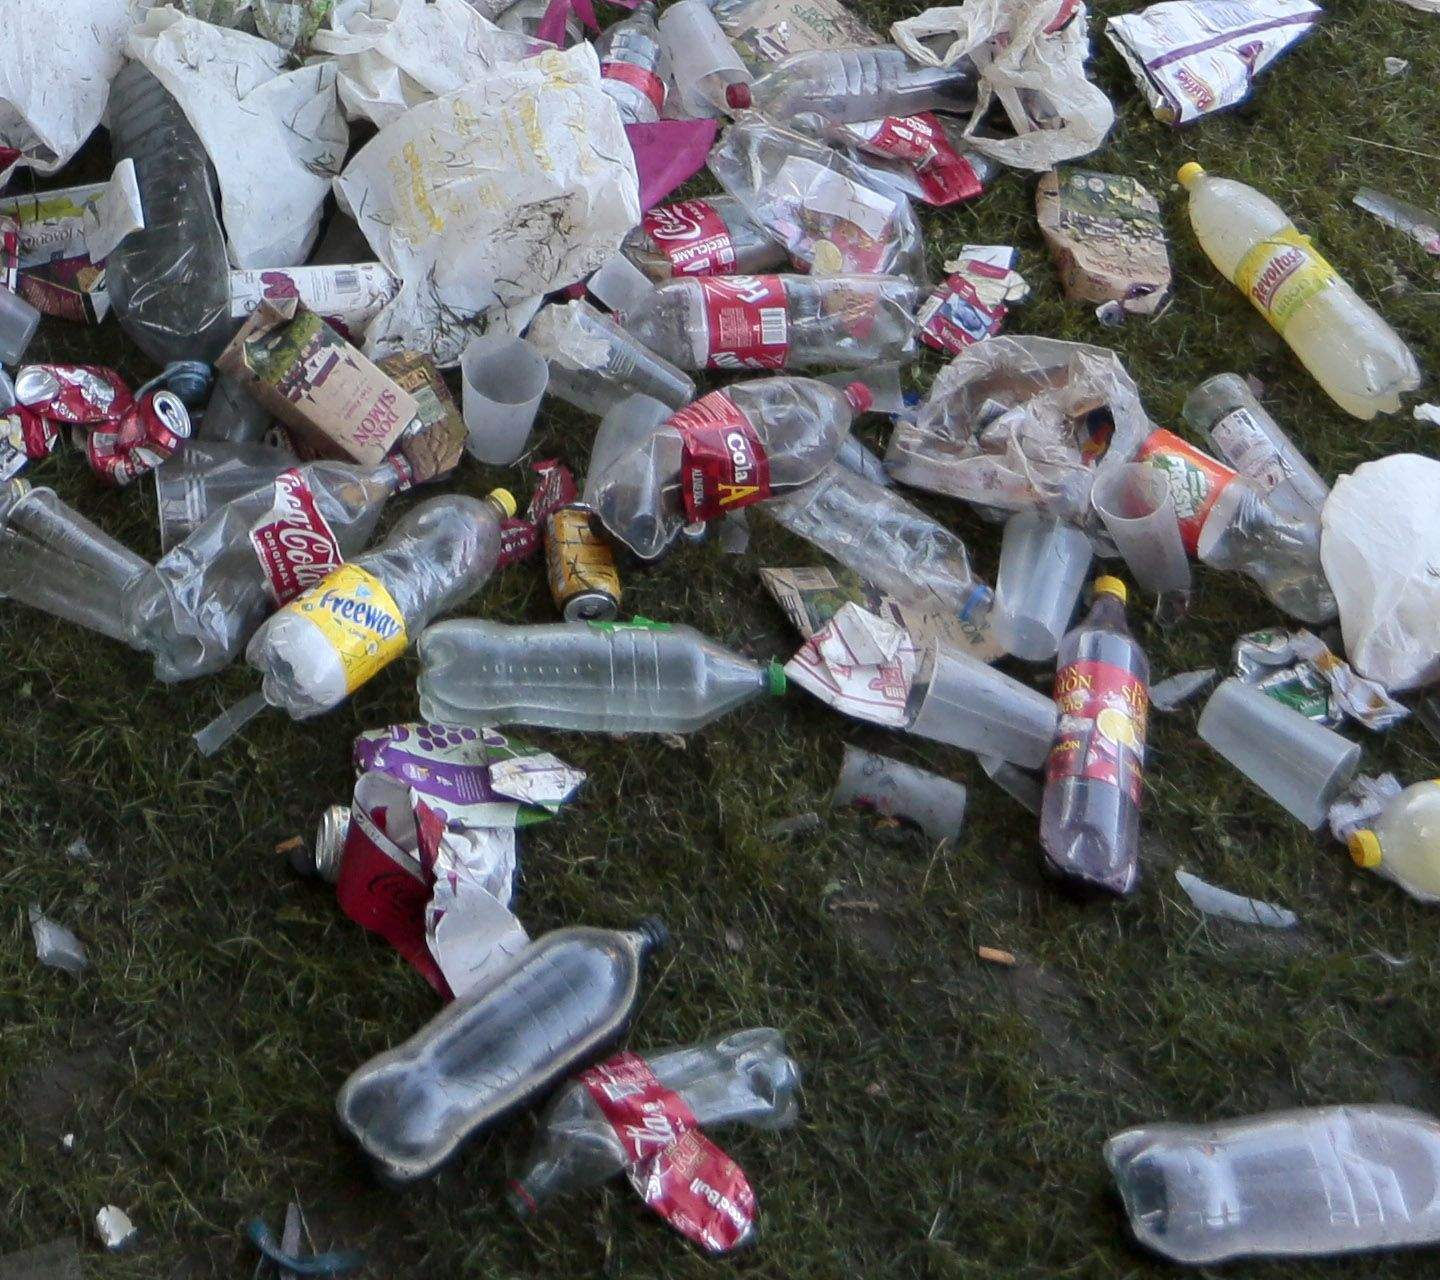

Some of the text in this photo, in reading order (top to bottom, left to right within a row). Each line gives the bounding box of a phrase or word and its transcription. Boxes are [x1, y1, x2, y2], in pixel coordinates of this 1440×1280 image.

[670, 234, 730, 263] RECICLAME
[352, 389, 398, 445] SIMON
[726, 430, 748, 483] Cola
[263, 529, 291, 588] ORIGINAL
[319, 588, 402, 639] Freeway
